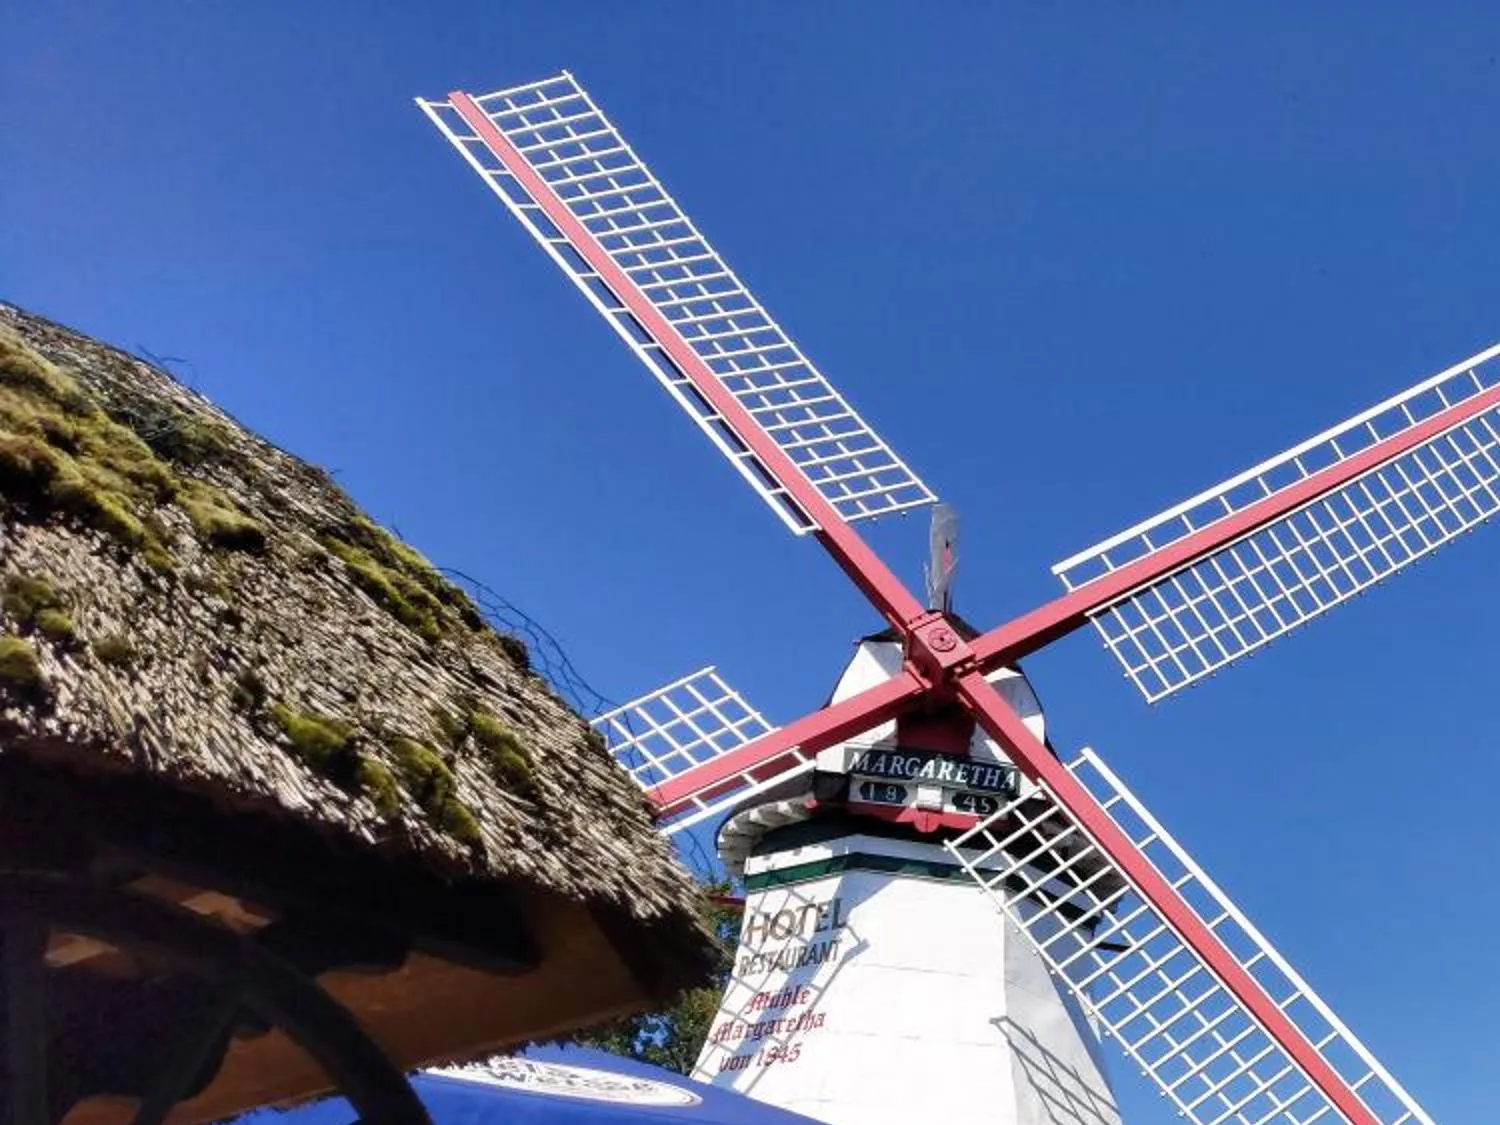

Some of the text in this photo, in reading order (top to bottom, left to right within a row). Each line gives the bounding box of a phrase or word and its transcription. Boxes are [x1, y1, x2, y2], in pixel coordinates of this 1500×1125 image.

[847, 752, 1016, 790] MARGARETHA
[741, 898, 847, 949] HOTEL
[737, 938, 842, 977] RESTAURANT
[709, 1008, 826, 1045] Margaretha
[719, 1052, 755, 1073] von
